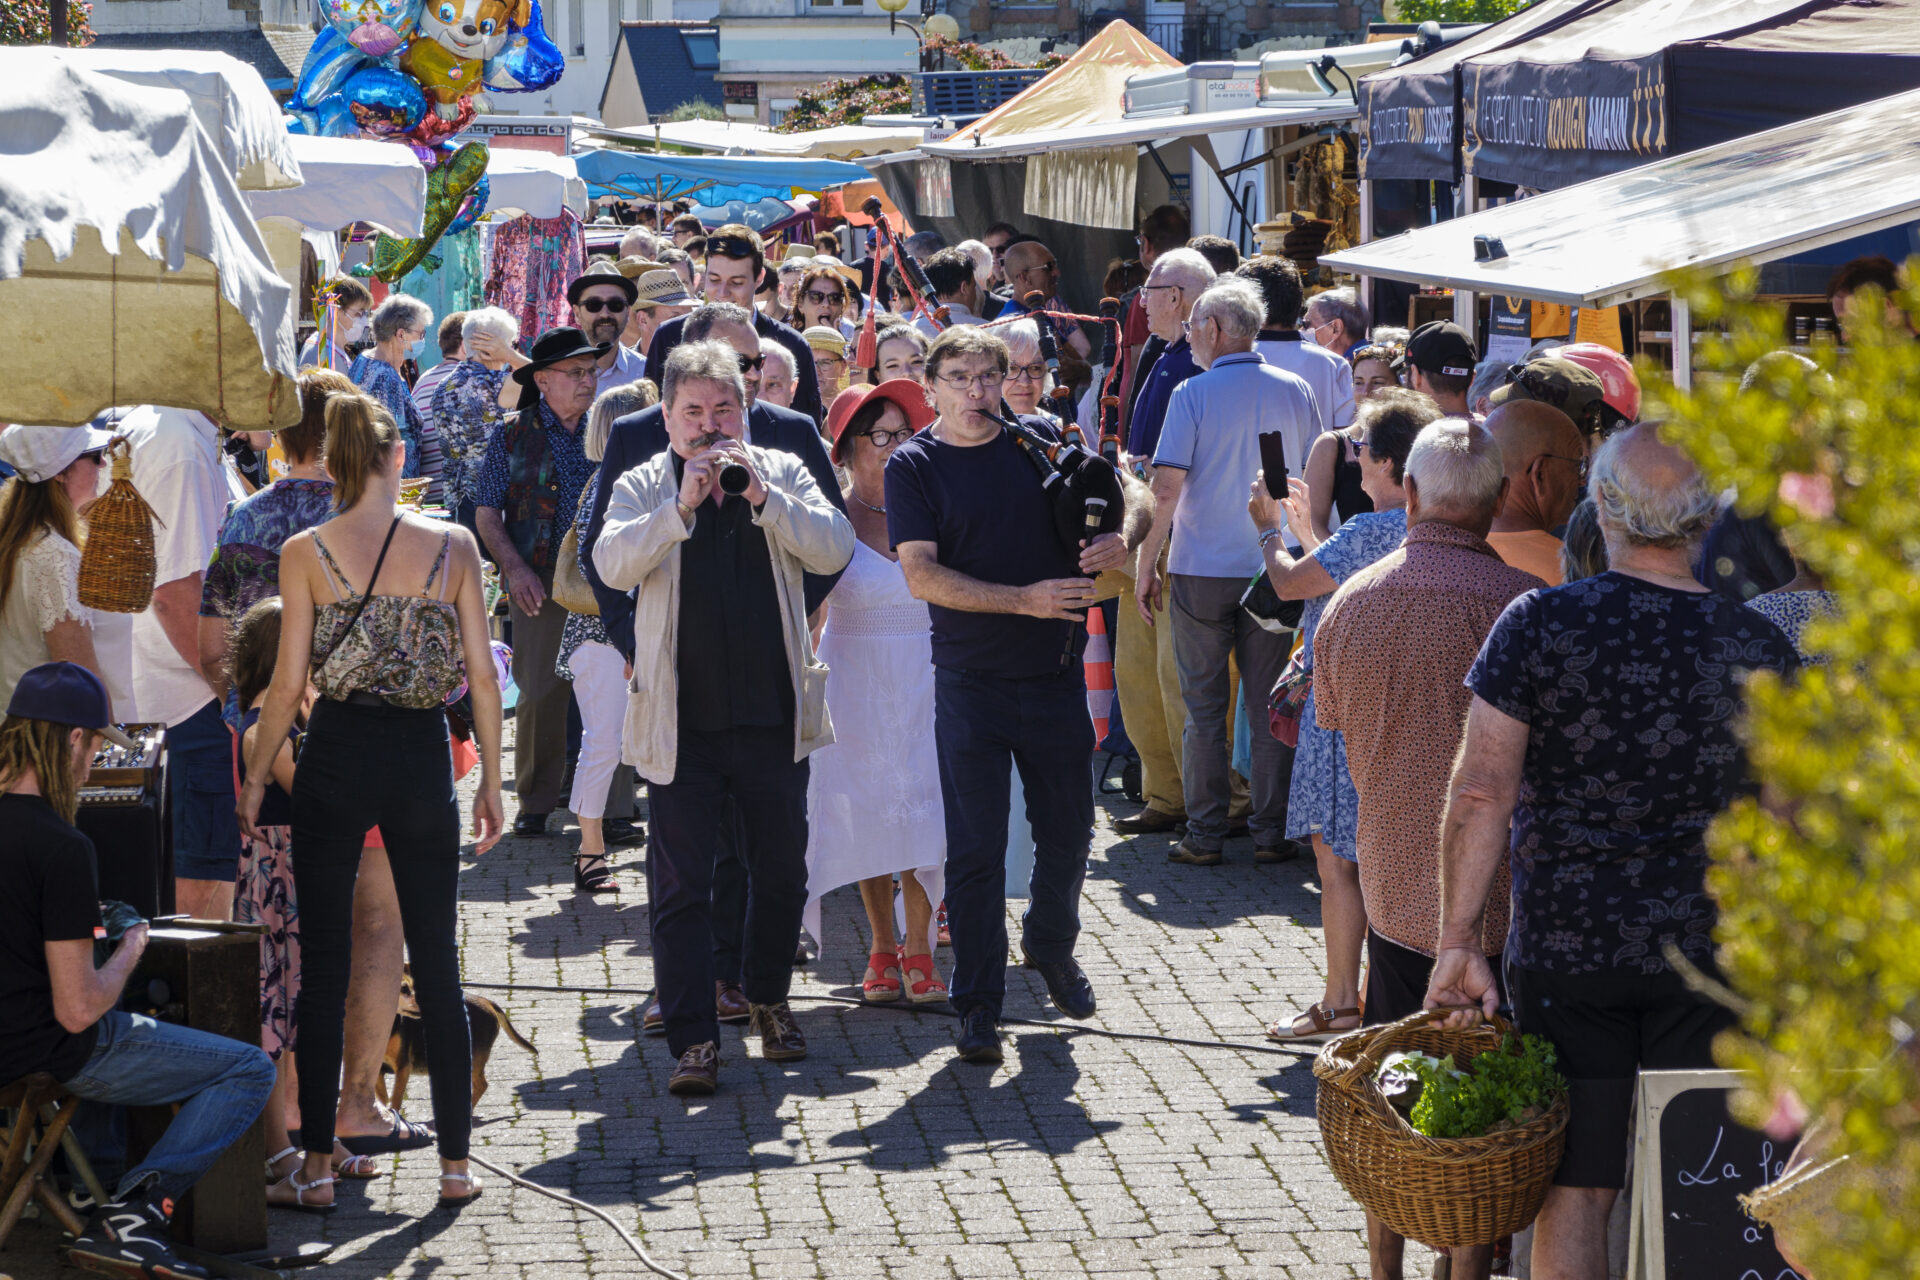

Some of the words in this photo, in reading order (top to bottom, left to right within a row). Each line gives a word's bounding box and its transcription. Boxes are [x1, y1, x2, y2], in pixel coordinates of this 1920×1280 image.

[1547, 96, 1586, 149] KOUIGN
[1588, 96, 1630, 150] AMANN
[1678, 1126, 1741, 1185] La
